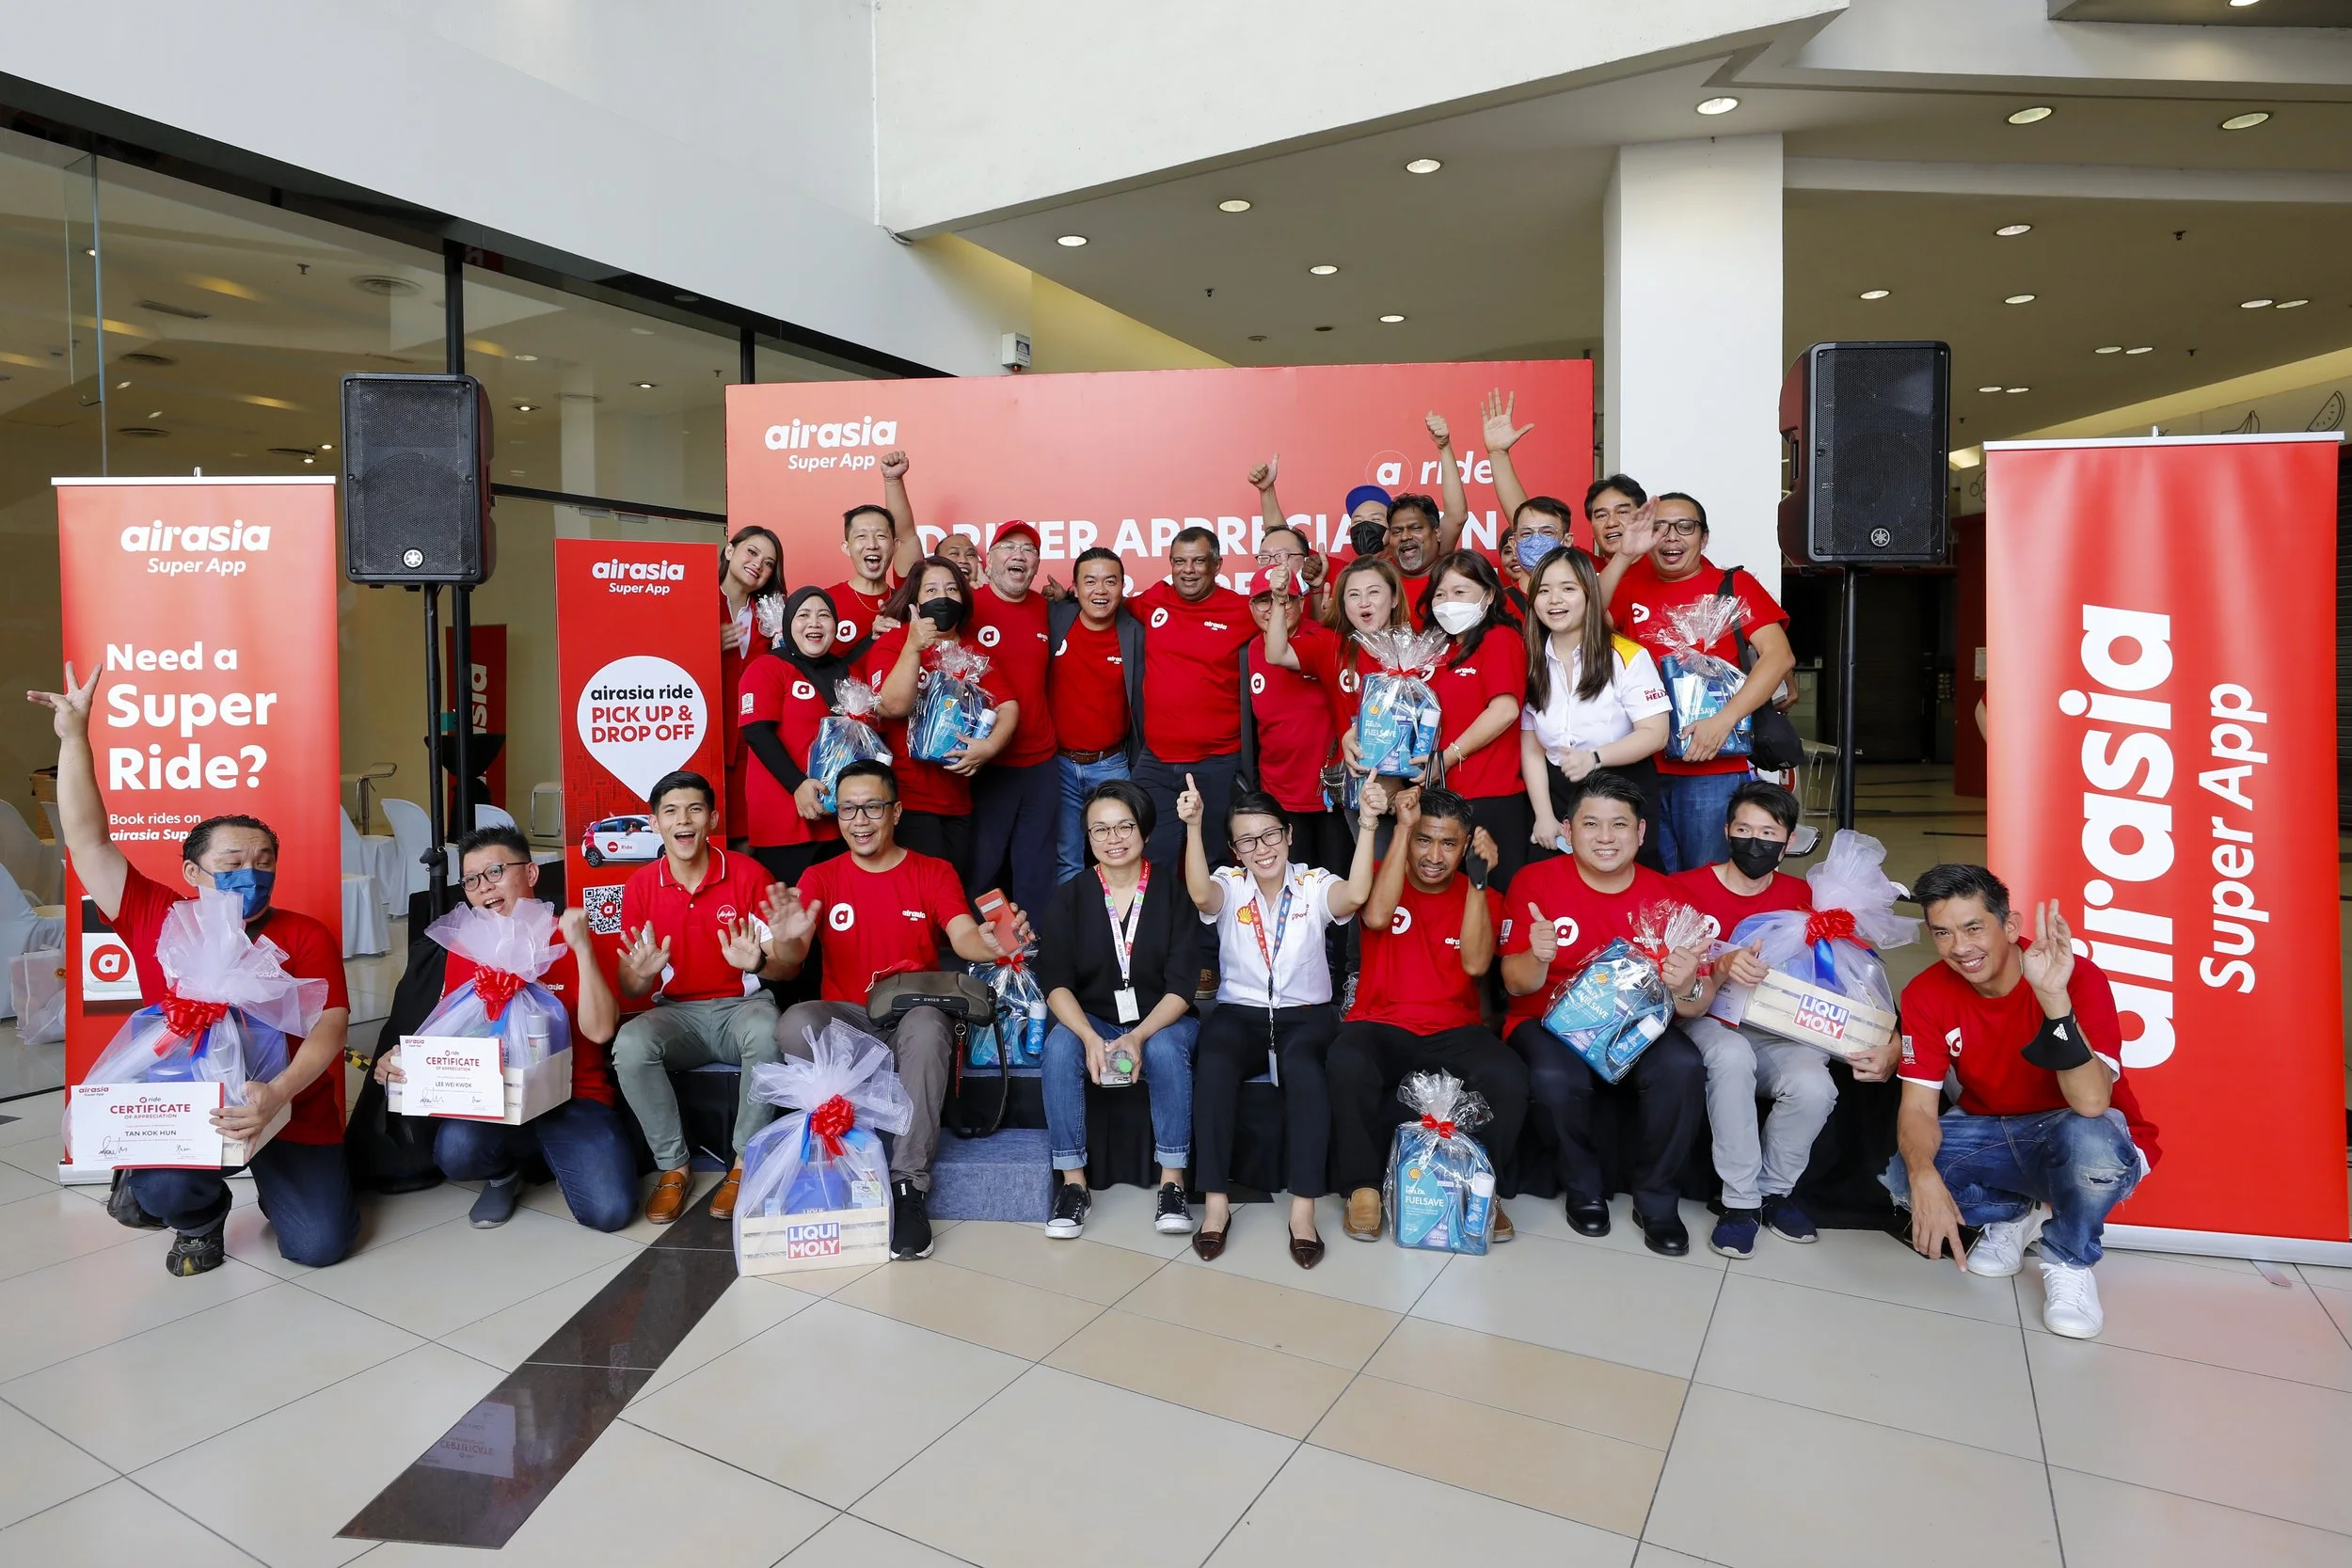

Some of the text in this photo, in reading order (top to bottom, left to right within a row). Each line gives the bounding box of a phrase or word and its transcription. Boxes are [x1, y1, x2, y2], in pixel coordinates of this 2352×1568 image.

[765, 415, 898, 451] airasia
[787, 451, 876, 473] Super App
[120, 519, 271, 553] airasia
[916, 511, 1498, 561] DRIER APPRIAN
[147, 557, 246, 578] Super App
[592, 558, 685, 581] airasia
[609, 582, 671, 596] Super App
[106, 641, 238, 672] Need a
[591, 684, 693, 701] airasia ride
[106, 683, 278, 737] Super
[592, 705, 693, 723] PICK UP &
[591, 724, 695, 743] DROP OFF
[109, 743, 268, 791] Ride?
[109, 812, 201, 825] Book rides on
[109, 829, 191, 843] airasia Sup
[2058, 604, 2177, 1069] airasia
[2199, 682, 2269, 994] Super App
[902, 910, 927, 919] airasia
[1445, 937, 1461, 945] aira
[1801, 995, 1848, 1023] LIQUI
[1796, 1010, 1844, 1037] MOLY
[425, 1056, 480, 1067] CERTIFICATE
[78, 1085, 109, 1094] airasia
[110, 1103, 191, 1115] CERTIFICATE
[1405, 1196, 1445, 1207] FUELSAVE
[789, 1223, 837, 1242] LIQUI
[789, 1240, 838, 1258] MOLY
